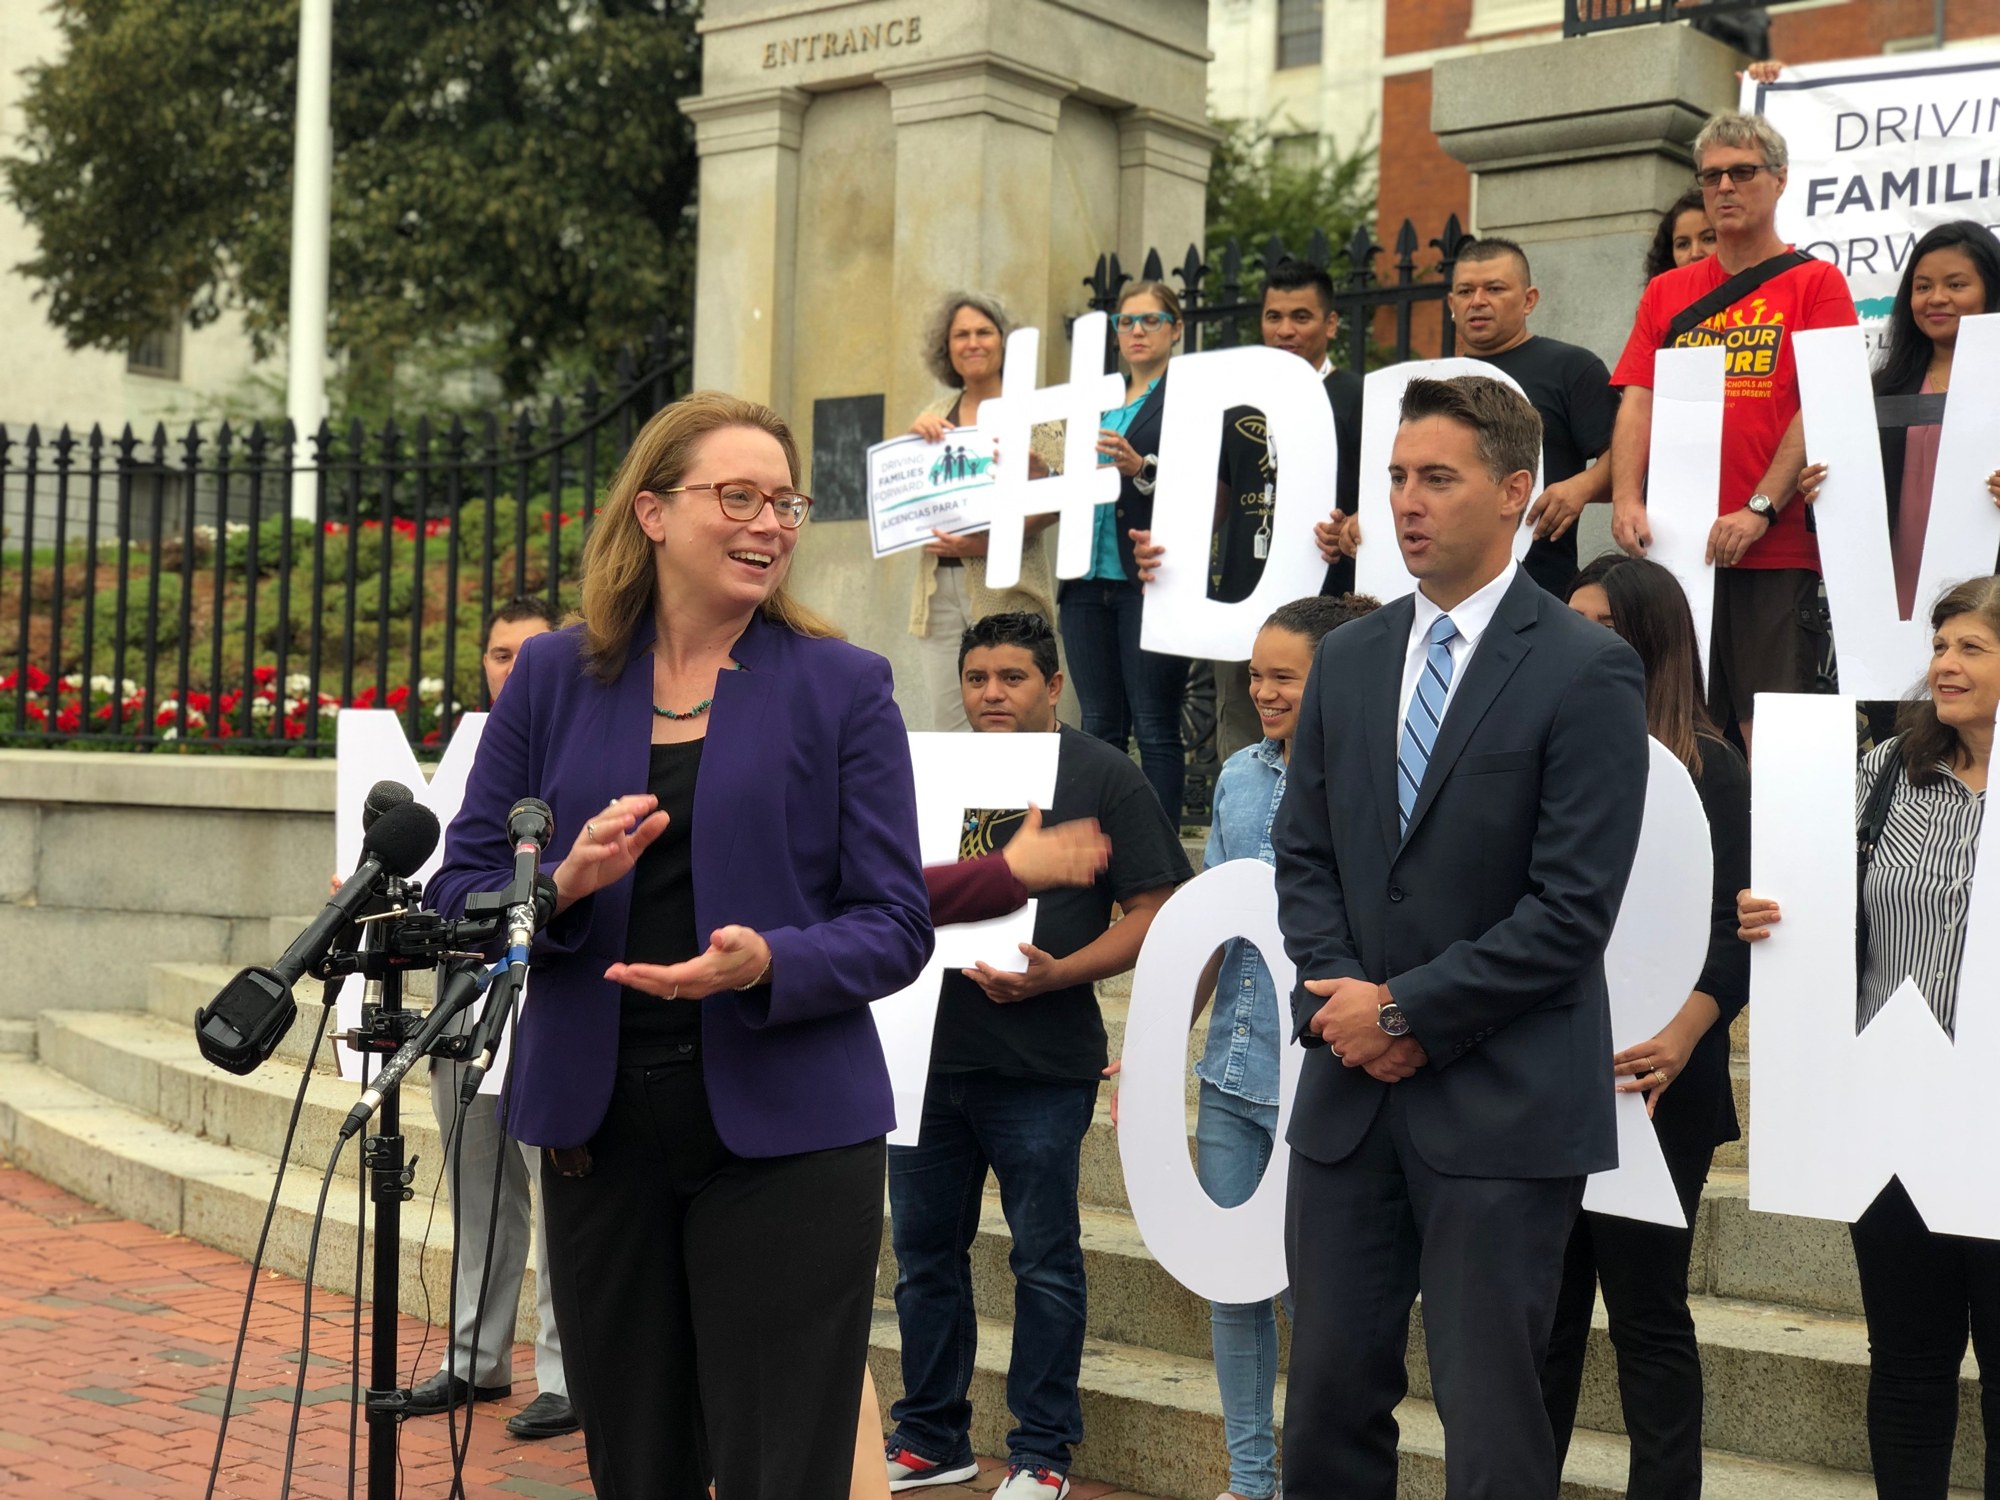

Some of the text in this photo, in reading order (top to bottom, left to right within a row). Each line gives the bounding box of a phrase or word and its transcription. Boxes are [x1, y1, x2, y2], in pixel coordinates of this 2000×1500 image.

[762, 15, 922, 69] ENTRANCE
[1806, 158, 2000, 217] FAMILI
[1726, 329, 1776, 348] OUR
[1741, 389, 1772, 398] DESERVE
[1757, 380, 1773, 389] AND
[882, 455, 924, 472] DRIVING
[879, 468, 924, 487] FAMILIES
[874, 481, 924, 502] FORWARD
[932, 501, 959, 514] PARA
